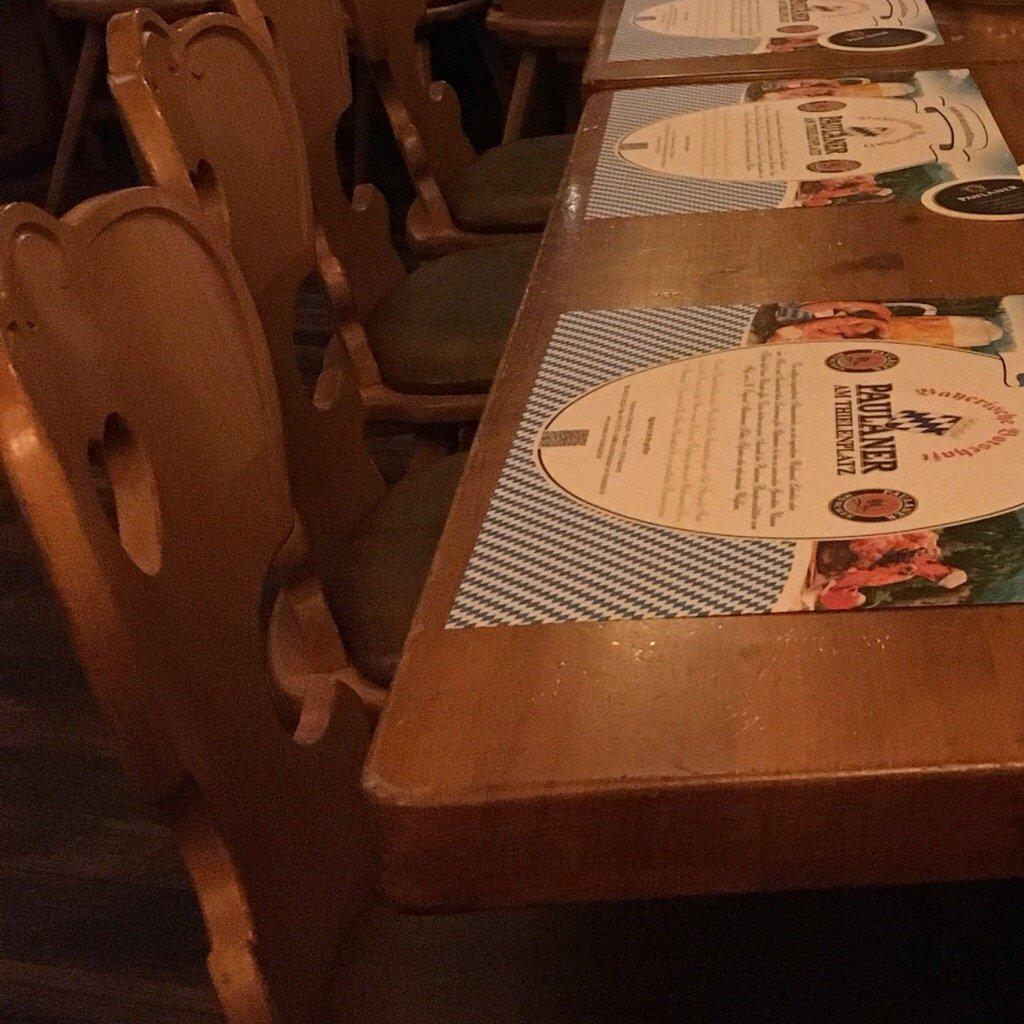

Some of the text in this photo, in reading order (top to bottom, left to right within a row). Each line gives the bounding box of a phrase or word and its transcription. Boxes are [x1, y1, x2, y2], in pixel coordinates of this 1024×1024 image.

[834, 385, 852, 398] AM
[856, 383, 898, 475] PAULANER
[835, 401, 856, 476] THIELENPLATZ
